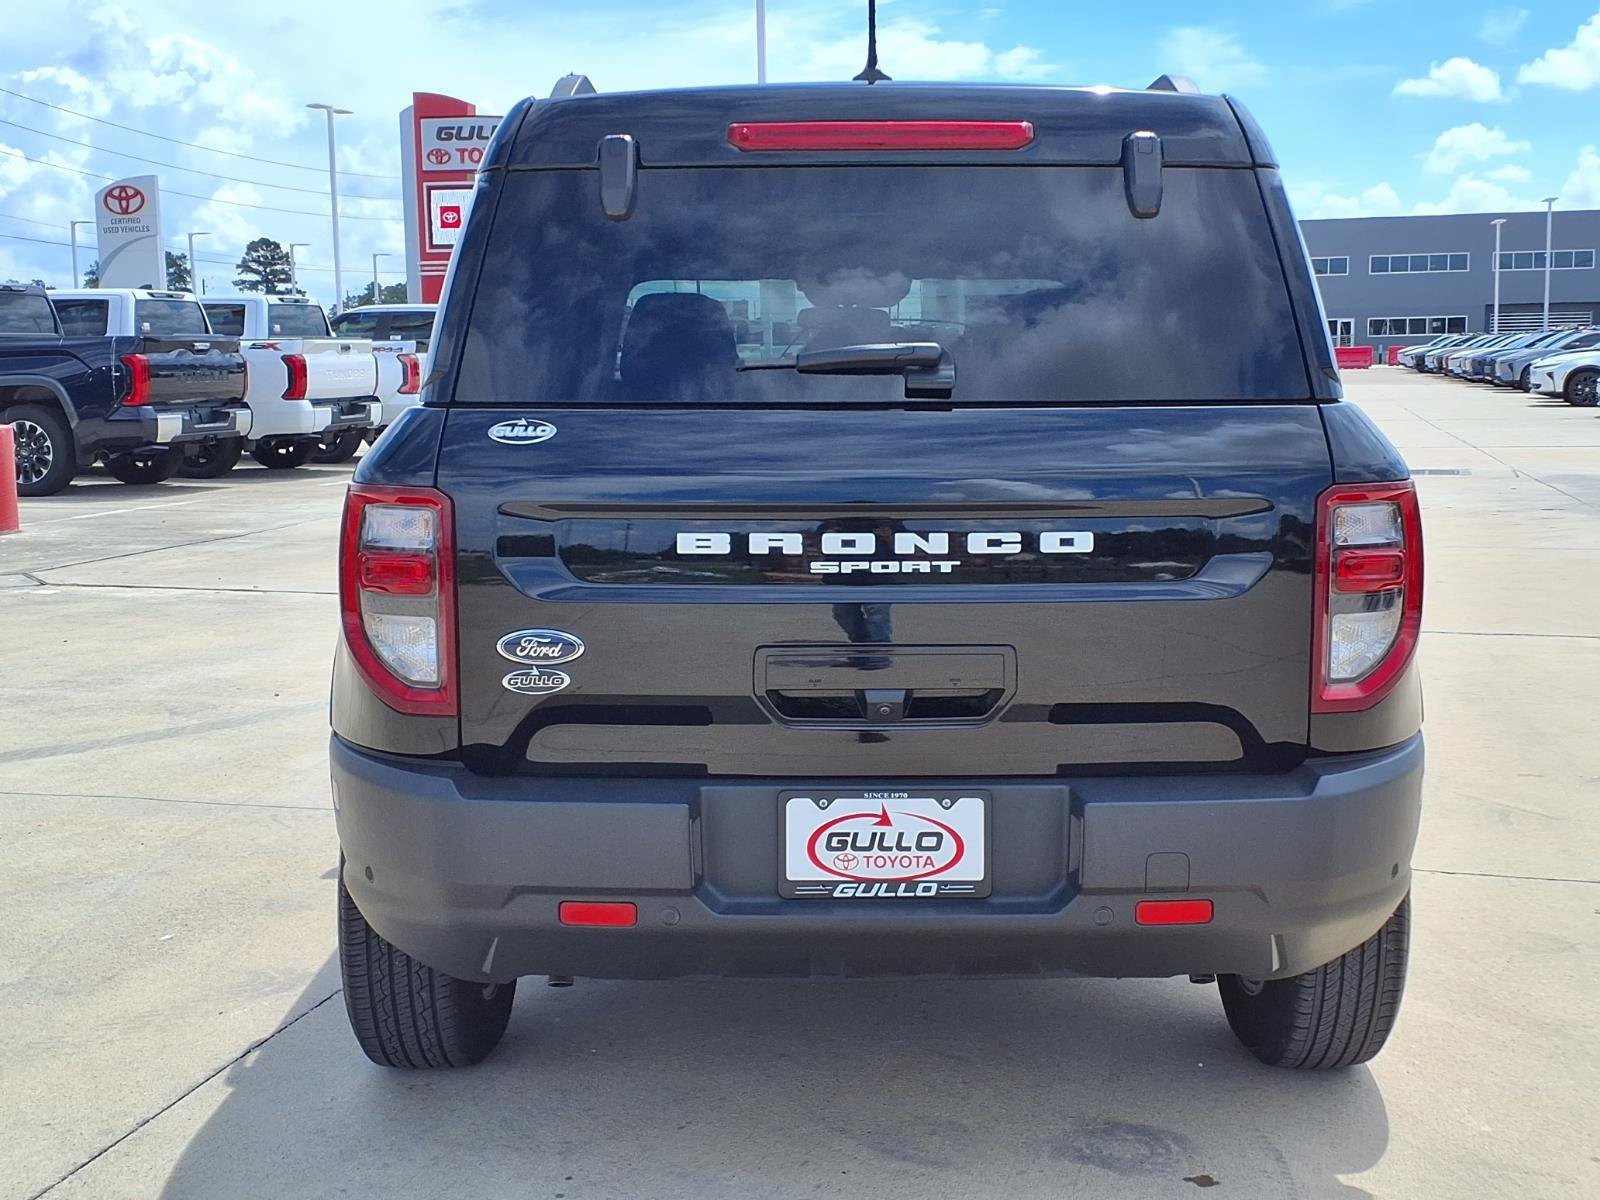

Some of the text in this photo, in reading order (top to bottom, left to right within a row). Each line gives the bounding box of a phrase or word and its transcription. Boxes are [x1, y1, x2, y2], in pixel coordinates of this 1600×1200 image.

[455, 147, 486, 164] TO
[110, 217, 141, 225] CERTIFIED
[103, 225, 150, 234] USED VEHICLES
[493, 426, 551, 437] GULLO
[676, 531, 1094, 555] BRONCO
[809, 560, 961, 575] SPORT
[516, 636, 563, 657] Ford
[507, 675, 566, 687] GULLO
[825, 831, 944, 852] GULLO
[863, 855, 935, 869] TOYOTA
[832, 882, 938, 898] GULLO
